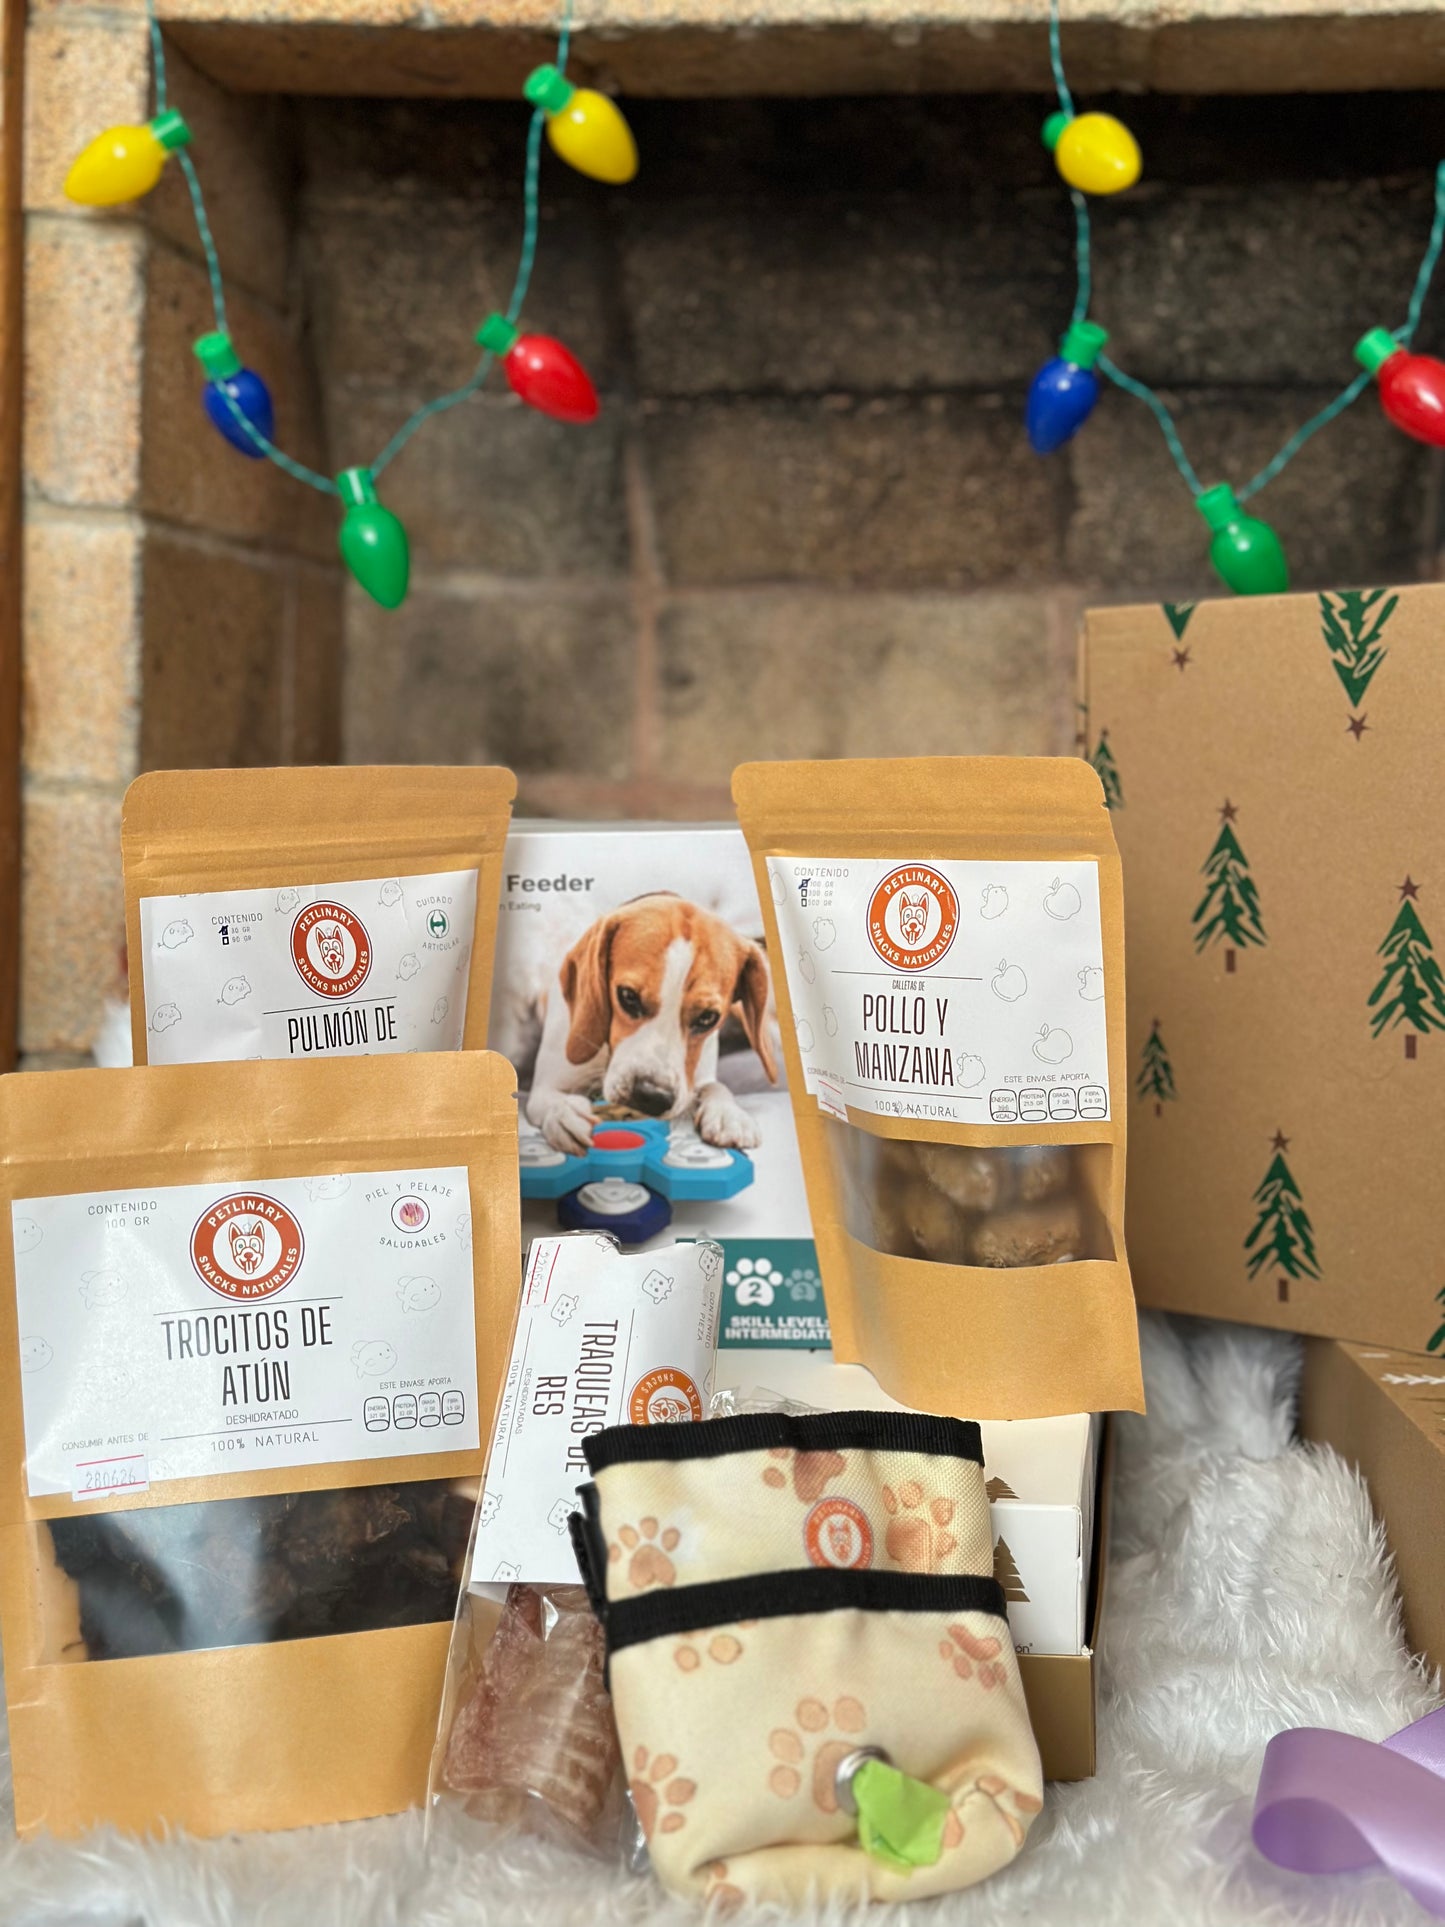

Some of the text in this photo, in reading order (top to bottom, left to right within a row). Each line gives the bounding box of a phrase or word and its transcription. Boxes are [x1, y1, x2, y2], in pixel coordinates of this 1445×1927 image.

[506, 874, 595, 892] Feeder
[794, 867, 849, 877] CONTENIDO
[884, 871, 946, 895] PETLINARY
[415, 896, 453, 908] CUIDADO
[508, 901, 542, 912] Eating
[211, 912, 263, 925] CONTENIDO
[299, 907, 354, 931] PETLINARY
[422, 938, 461, 951] ARTICULAR
[872, 921, 953, 965] SNACKS NATURALES
[298, 950, 368, 992] SNACKS NATURALES
[863, 994, 948, 1036] POLLO Y
[288, 1006, 398, 1053] PULMÓN DE
[854, 1041, 954, 1087] MANZANA
[1004, 1073, 1090, 1083] ESTE ENVASE APORTA
[906, 1103, 958, 1118] NATURAL
[365, 1182, 453, 1202] PIEL Y PELAJE
[88, 1201, 157, 1216] CONTENIDO
[208, 1199, 284, 1228] PETLINARY
[105, 1216, 150, 1230] 100 GR
[379, 1233, 446, 1249] SALUDABLES
[199, 1247, 298, 1295] SNACKS NATURALES
[748, 1282, 762, 1298] 2
[696, 1312, 706, 1341] PIEZA
[704, 1291, 716, 1350] CONTENIDO
[731, 1316, 774, 1328] SKILL
[161, 1306, 333, 1360] TROCITOS DE
[222, 1357, 291, 1406] ATÚN
[380, 1377, 452, 1389] ESTE ENVASE APORTA
[570, 1319, 619, 1434] TRAQUEAS
[515, 1367, 533, 1435] DESHIDRATADAS
[532, 1376, 567, 1415] RES
[634, 1373, 675, 1425] SNACKS NATU
[226, 1410, 299, 1425] DESHIDRATADO
[495, 1395, 513, 1448] NATURAL
[62, 1432, 149, 1451] CONSUMIR ANTES DE
[211, 1431, 319, 1451] 100% NATURAL
